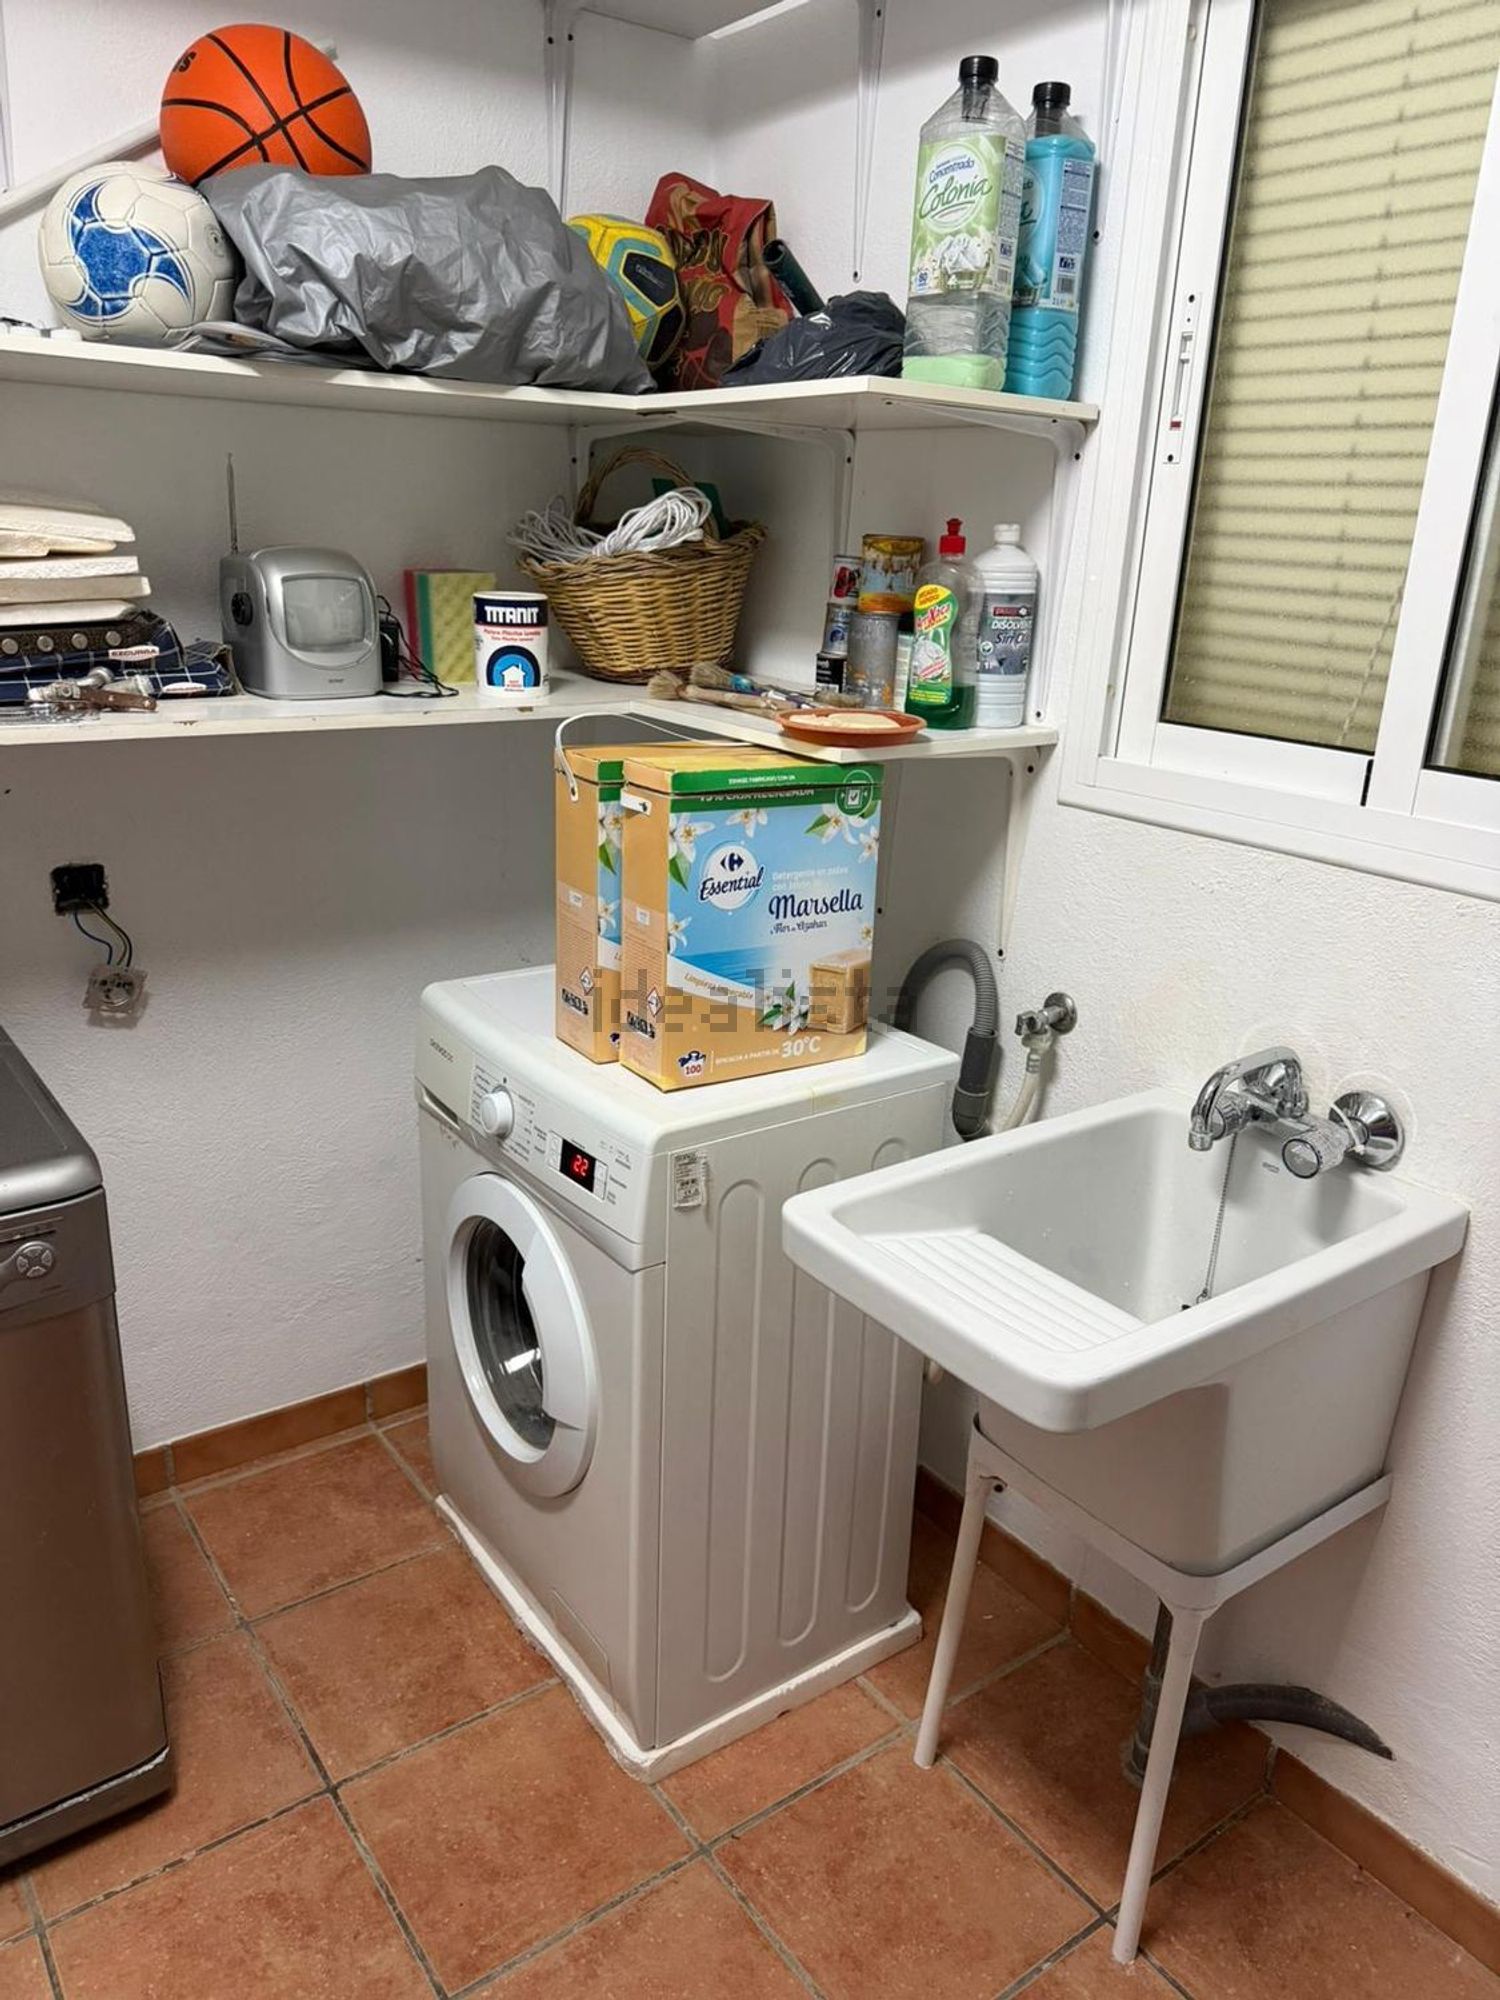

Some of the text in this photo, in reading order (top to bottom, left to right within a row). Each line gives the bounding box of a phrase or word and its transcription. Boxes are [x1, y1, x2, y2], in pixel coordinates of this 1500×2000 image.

[919, 174, 993, 219] Colonia
[484, 605, 539, 624] TITANIT
[700, 867, 764, 901] Essential
[768, 889, 863, 920] Marsella
[782, 1036, 822, 1059] 30°C
[685, 1064, 702, 1075] 100
[572, 1154, 589, 1177] 22
